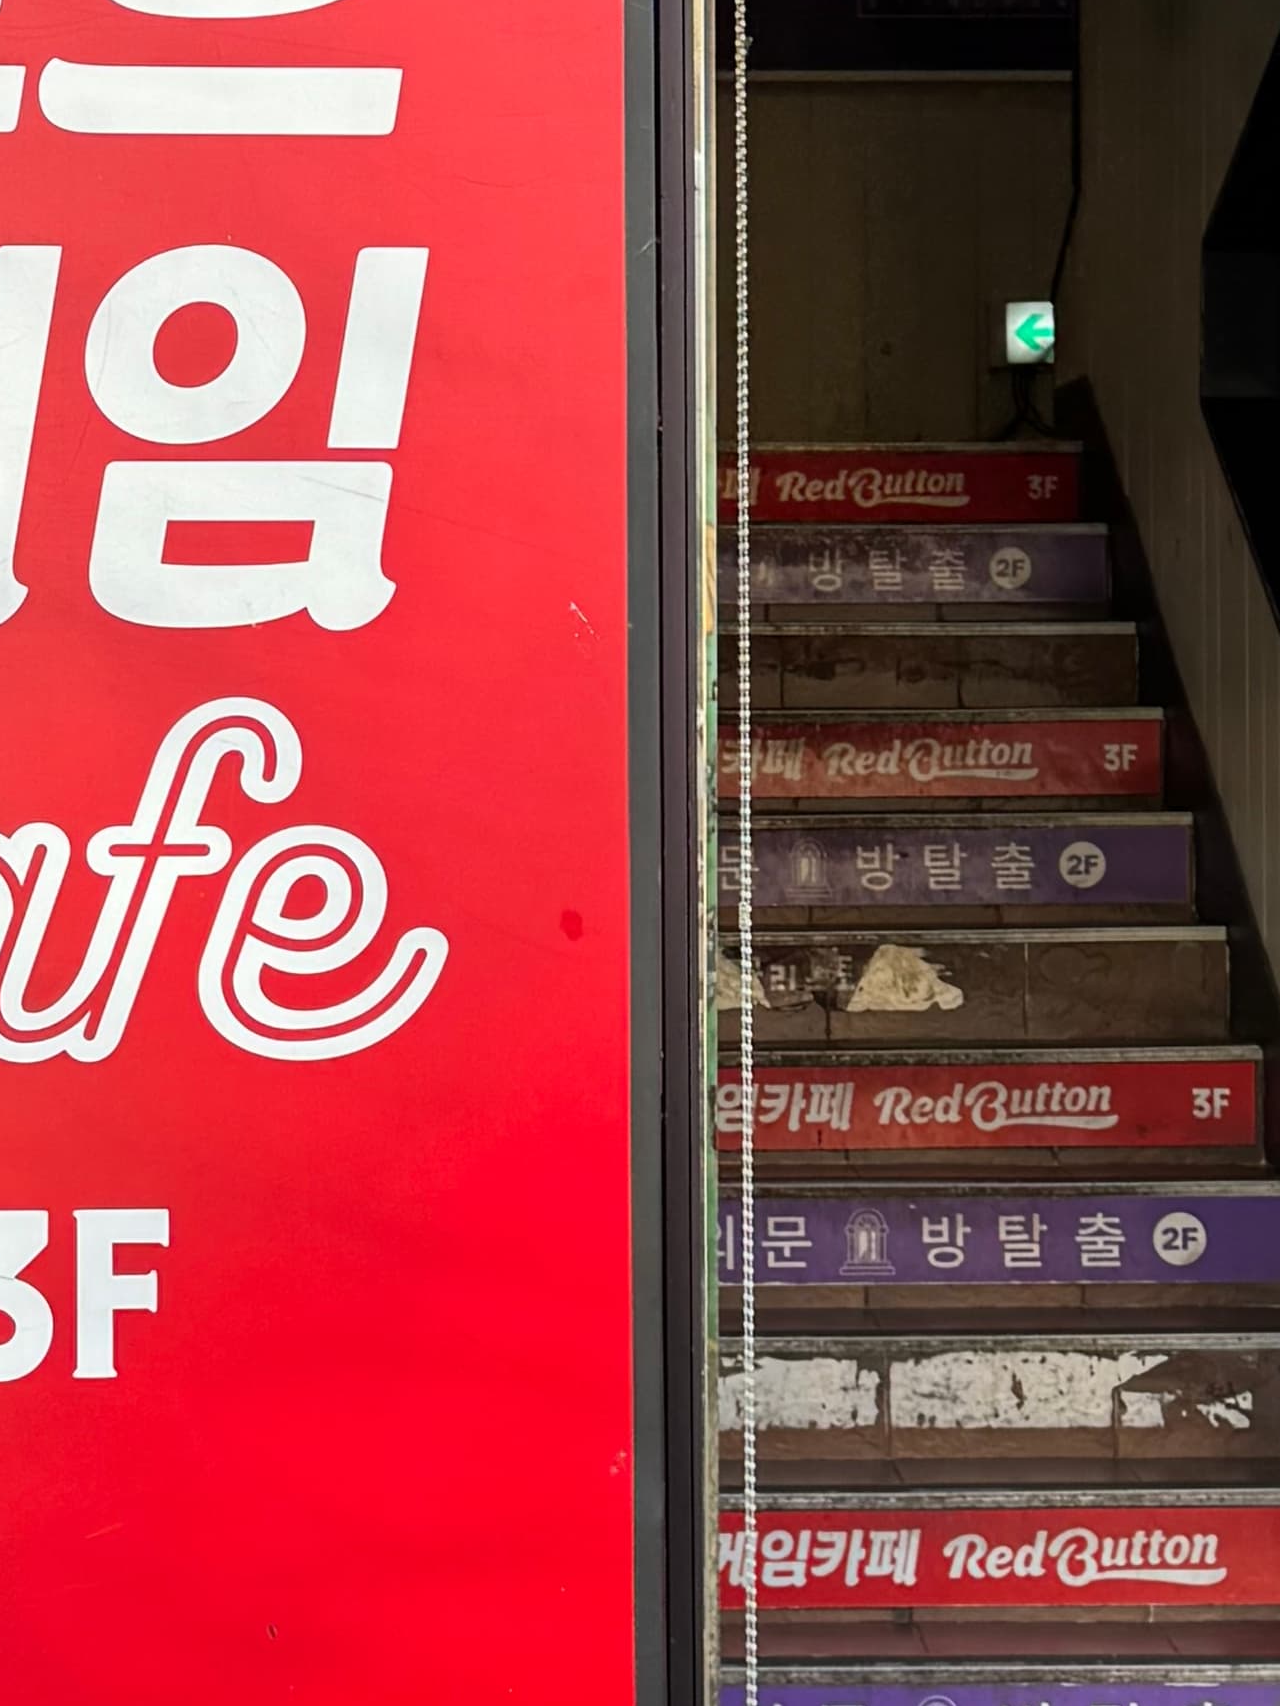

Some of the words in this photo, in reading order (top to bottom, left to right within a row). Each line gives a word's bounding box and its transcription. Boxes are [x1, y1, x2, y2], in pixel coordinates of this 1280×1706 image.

[1027, 475, 1059, 499] 3F
[995, 559, 1026, 578] 2F
[1104, 744, 1139, 771] 3F
[1066, 854, 1099, 876] 2F
[1193, 1088, 1231, 1119] 3F
[1161, 1227, 1199, 1251] 2F
